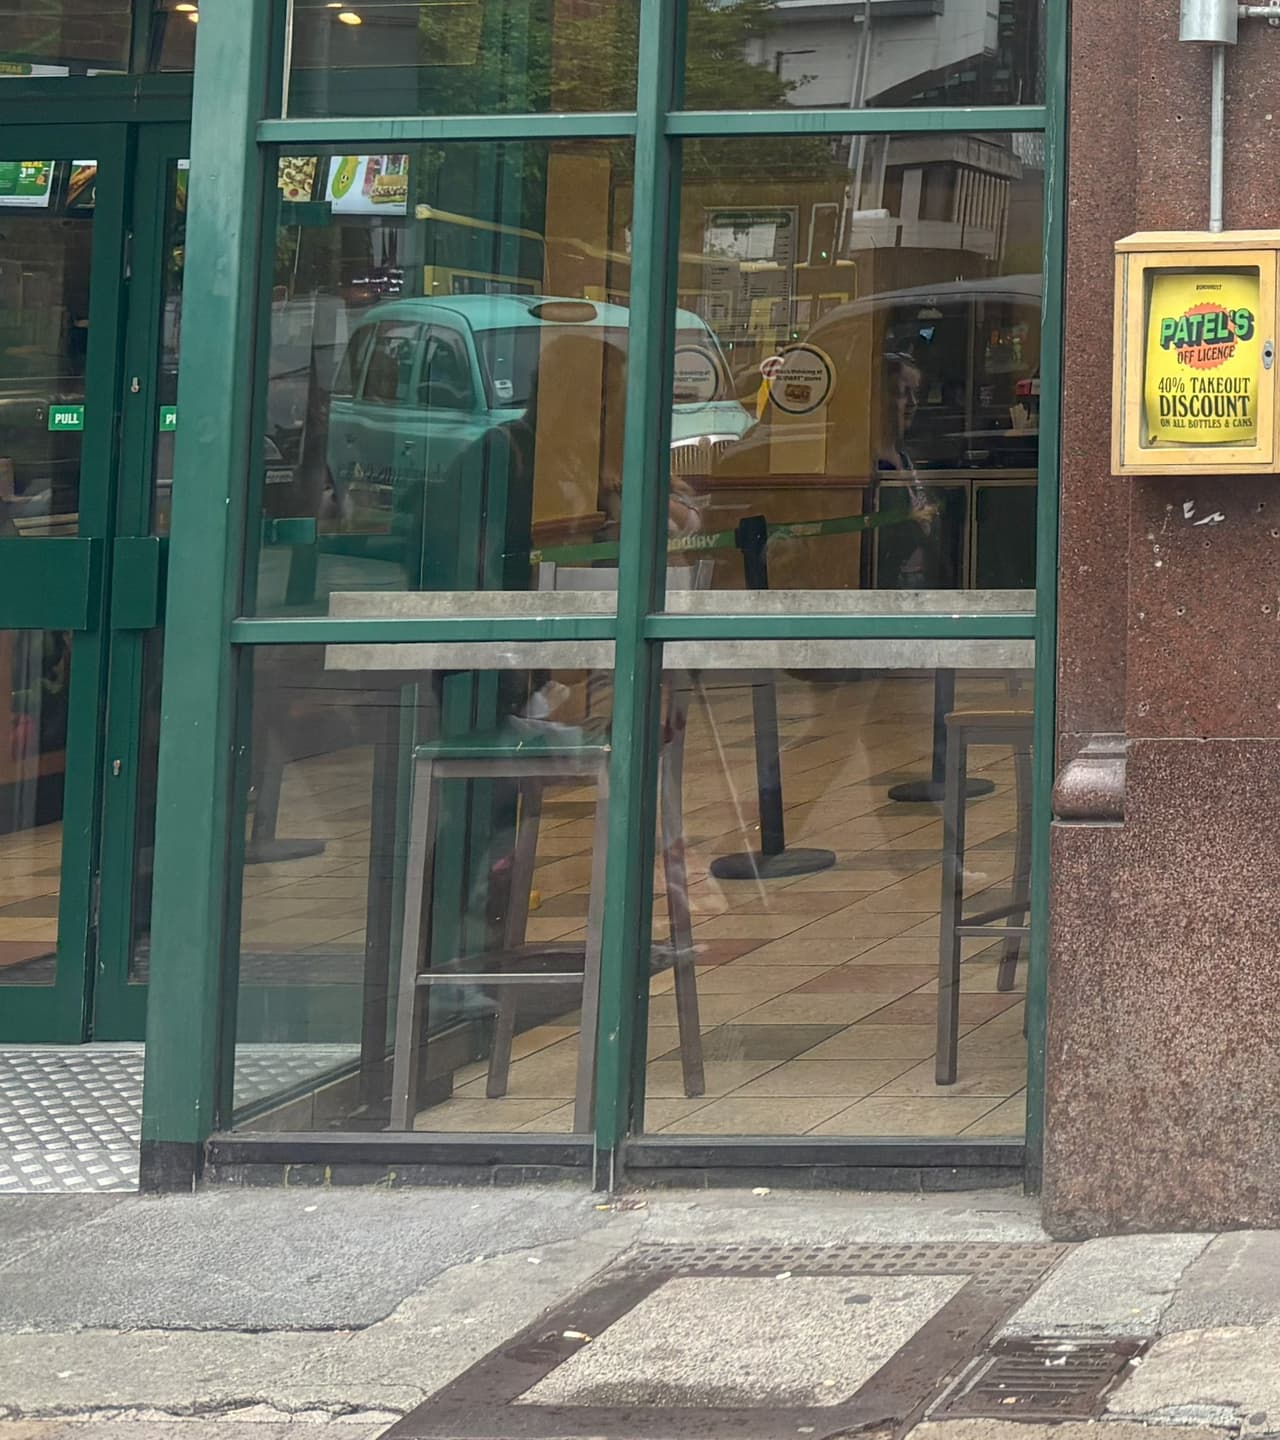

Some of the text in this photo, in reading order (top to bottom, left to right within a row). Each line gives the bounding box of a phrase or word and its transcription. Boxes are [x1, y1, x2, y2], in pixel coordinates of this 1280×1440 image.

[1160, 307, 1256, 350] PATEL'S
[1177, 344, 1236, 365] OFF LICENCE
[1158, 376, 1251, 393] 40% TAKEOUT
[1159, 395, 1251, 418] DISCOUNT
[55, 413, 79, 424] PULL
[1160, 418, 1171, 428] ON
[1172, 418, 1187, 428] ALL
[1188, 418, 1222, 429] BOTTLES
[1232, 417, 1253, 428] CANS
